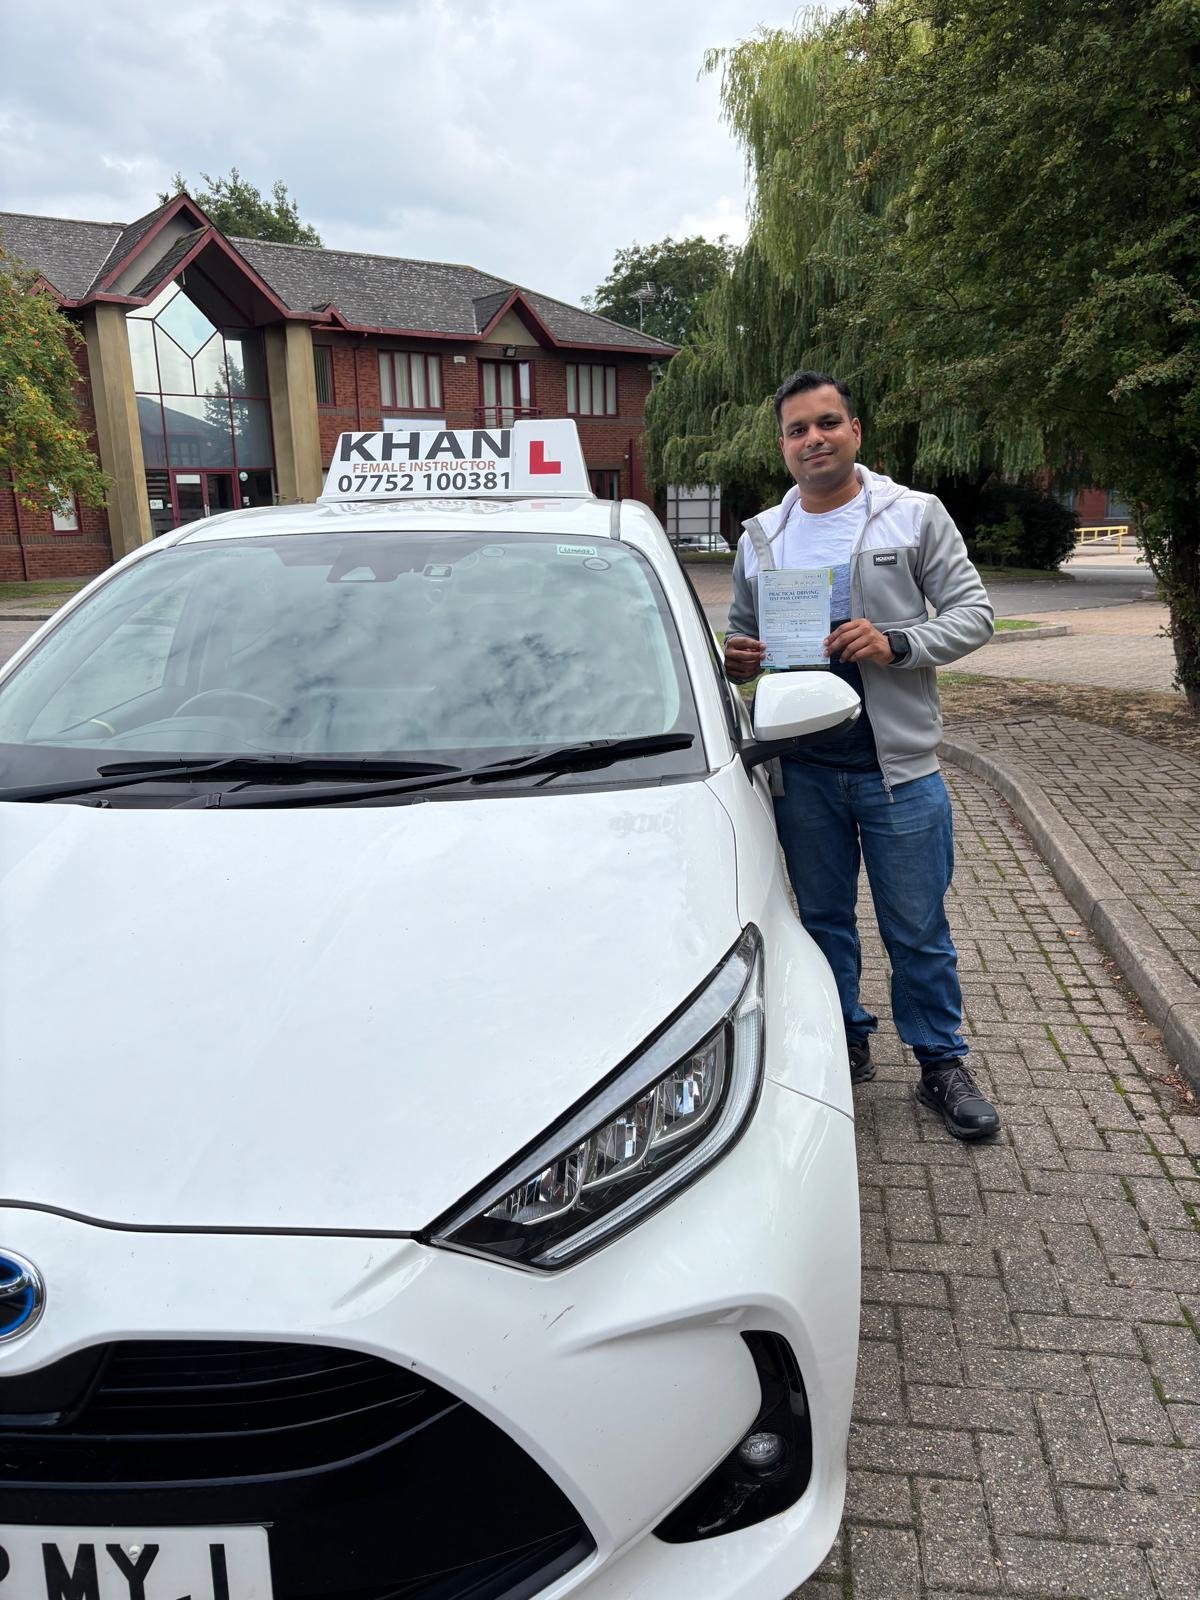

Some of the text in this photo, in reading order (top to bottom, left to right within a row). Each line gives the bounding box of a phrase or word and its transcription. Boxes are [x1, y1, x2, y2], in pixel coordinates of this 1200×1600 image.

[340, 430, 511, 461] KHAN
[529, 441, 561, 474] L
[352, 460, 496, 473] FEMALE INSTRUCTOR
[338, 472, 510, 492] 07752 100381
